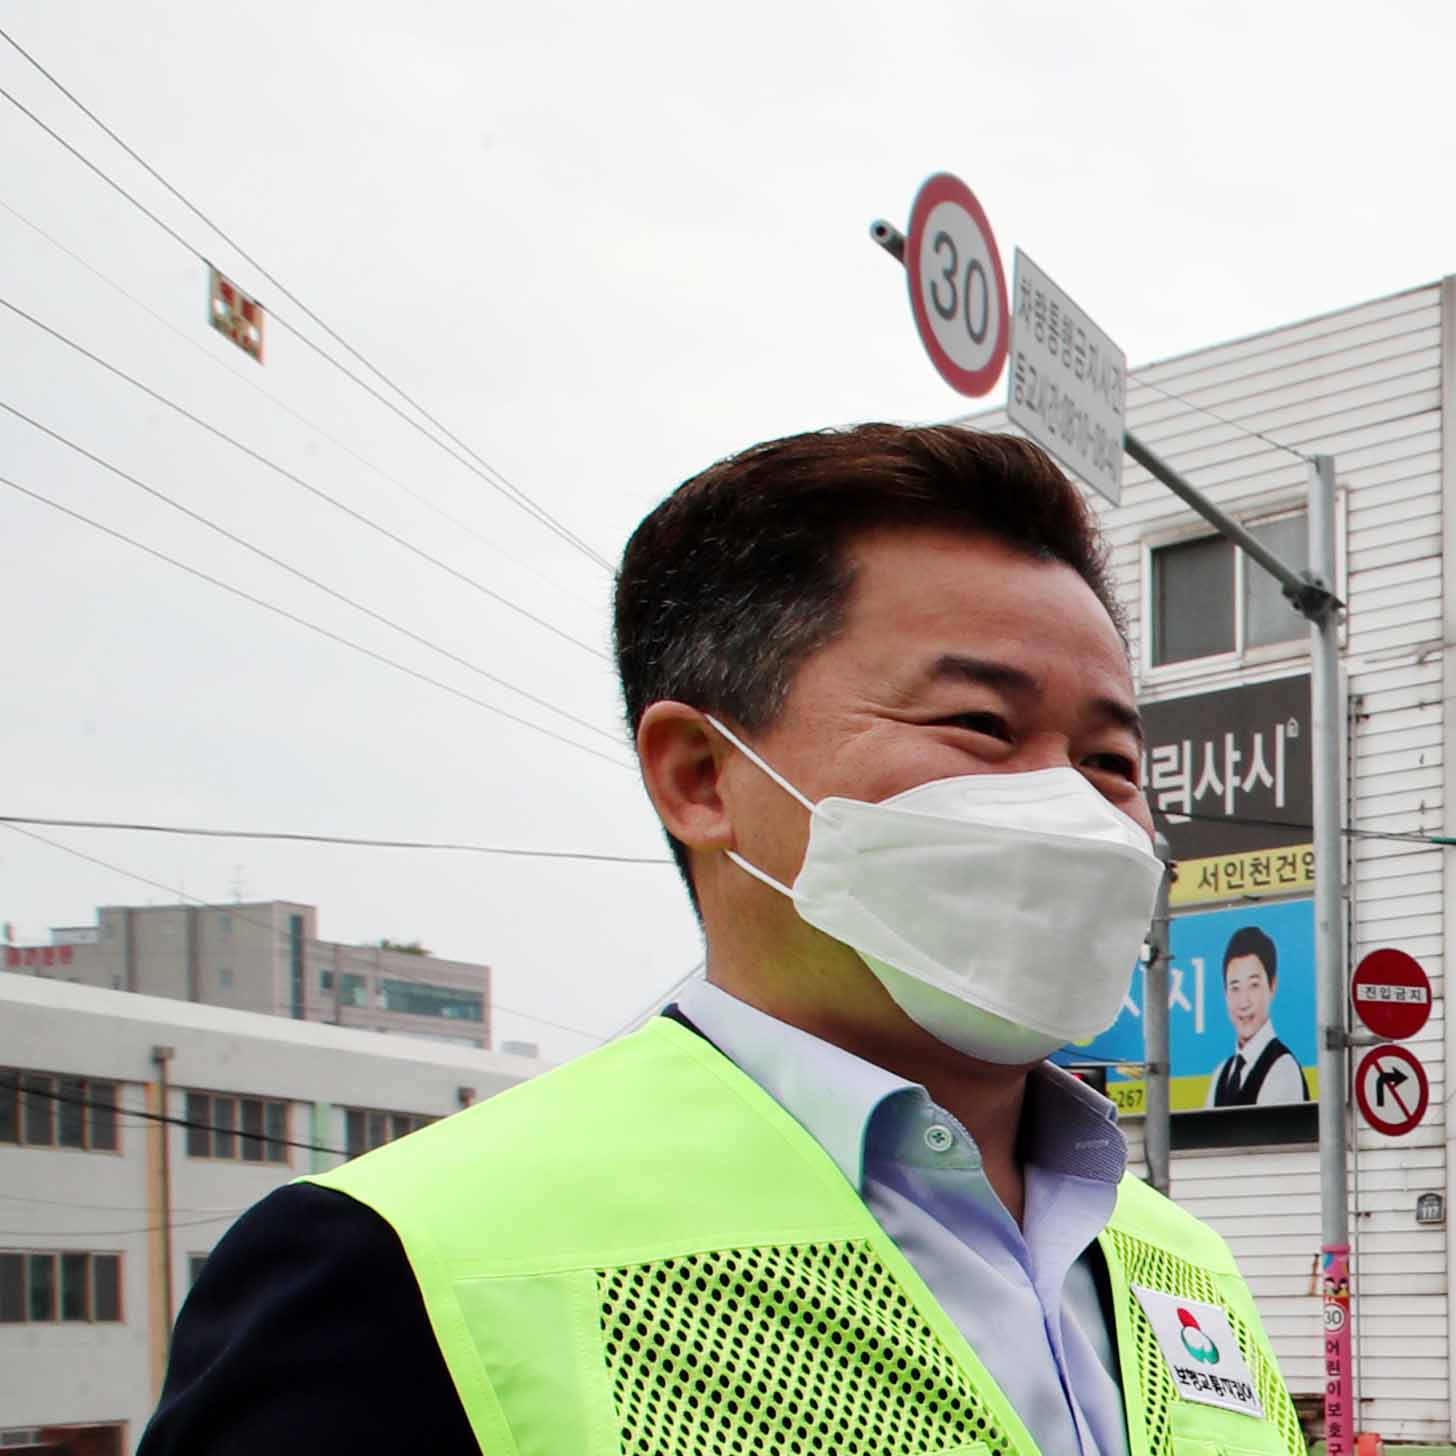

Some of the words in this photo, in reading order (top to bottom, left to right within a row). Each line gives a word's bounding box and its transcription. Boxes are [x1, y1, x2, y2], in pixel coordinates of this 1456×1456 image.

[930, 230, 989, 345] 30
[1141, 724, 1285, 824] 림샤시
[1365, 986, 1421, 1001] 진입금지
